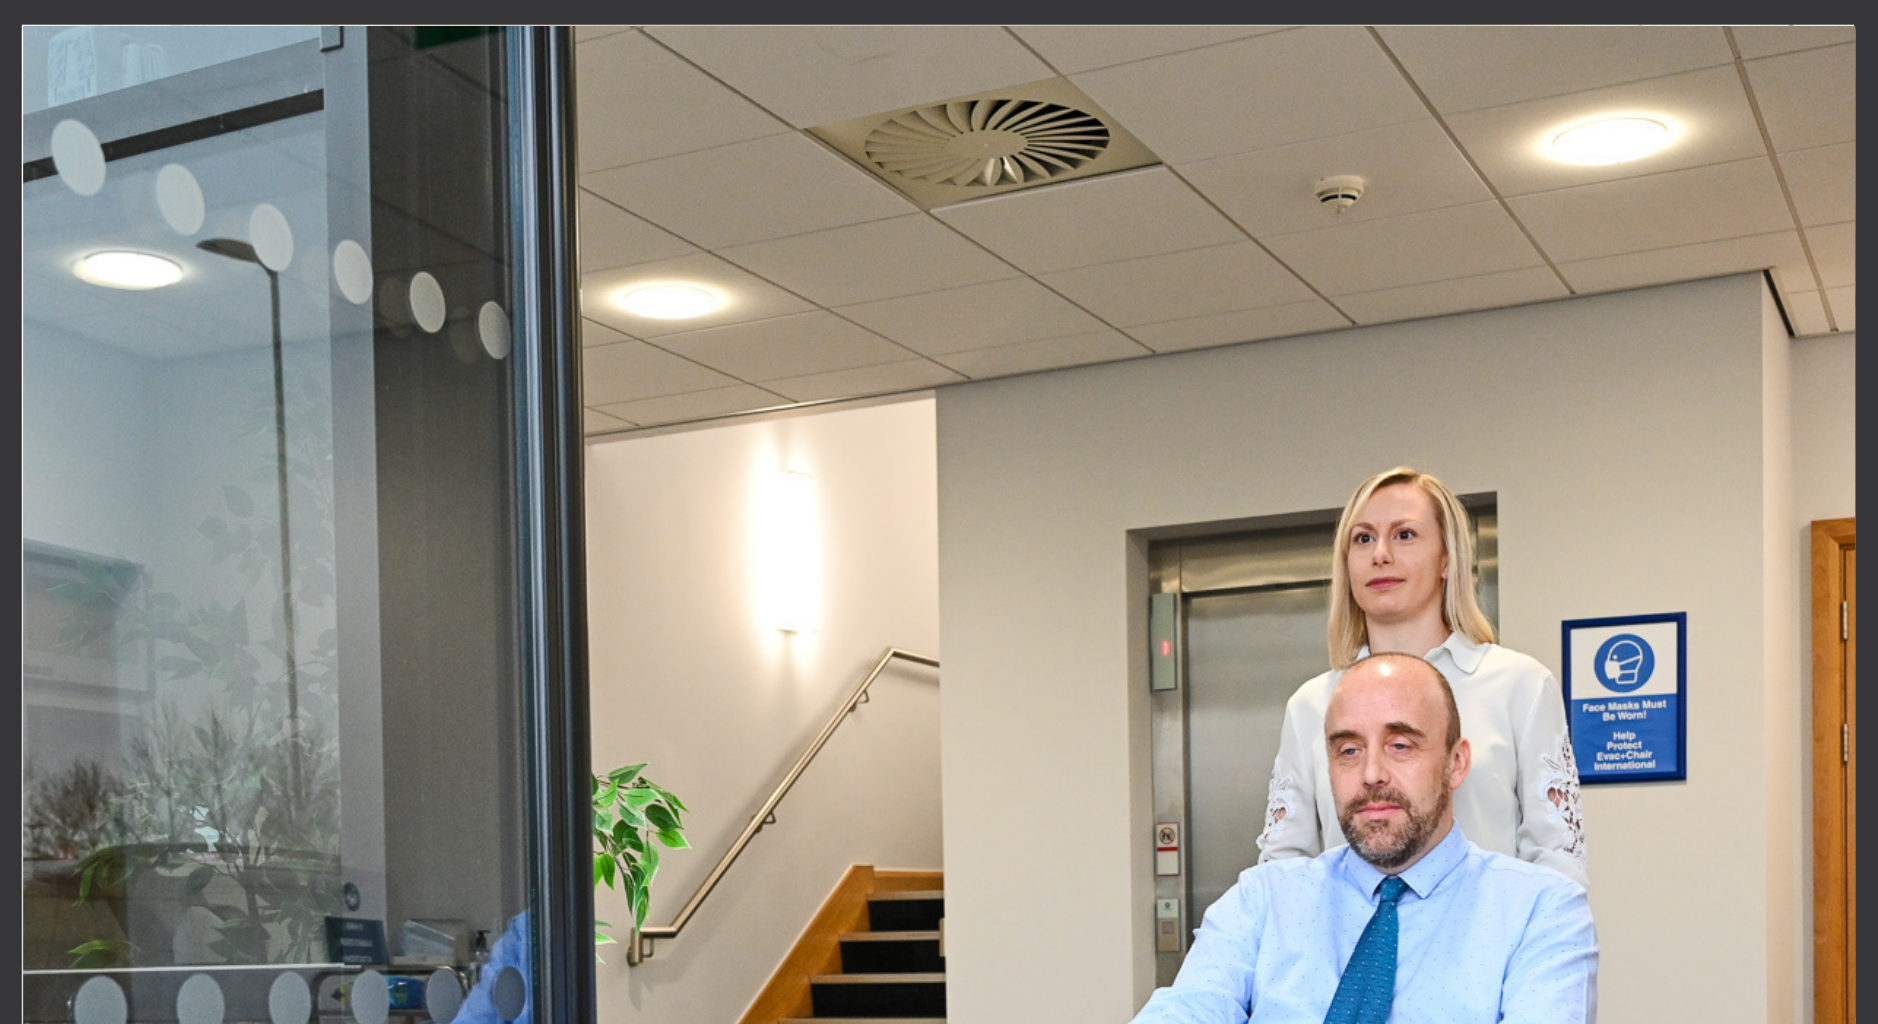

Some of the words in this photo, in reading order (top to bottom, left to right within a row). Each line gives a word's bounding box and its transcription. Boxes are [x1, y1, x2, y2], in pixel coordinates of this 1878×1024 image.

[1582, 703, 1606, 713] Face
[1608, 701, 1640, 711] Masks
[1642, 699, 1667, 709] Must
[1602, 712, 1616, 722] Be
[1617, 710, 1647, 721] Worn!
[1613, 731, 1637, 742] Help
[1607, 741, 1643, 751] Protect
[1596, 750, 1653, 761] Evac+Chair
[1594, 759, 1656, 771] International
